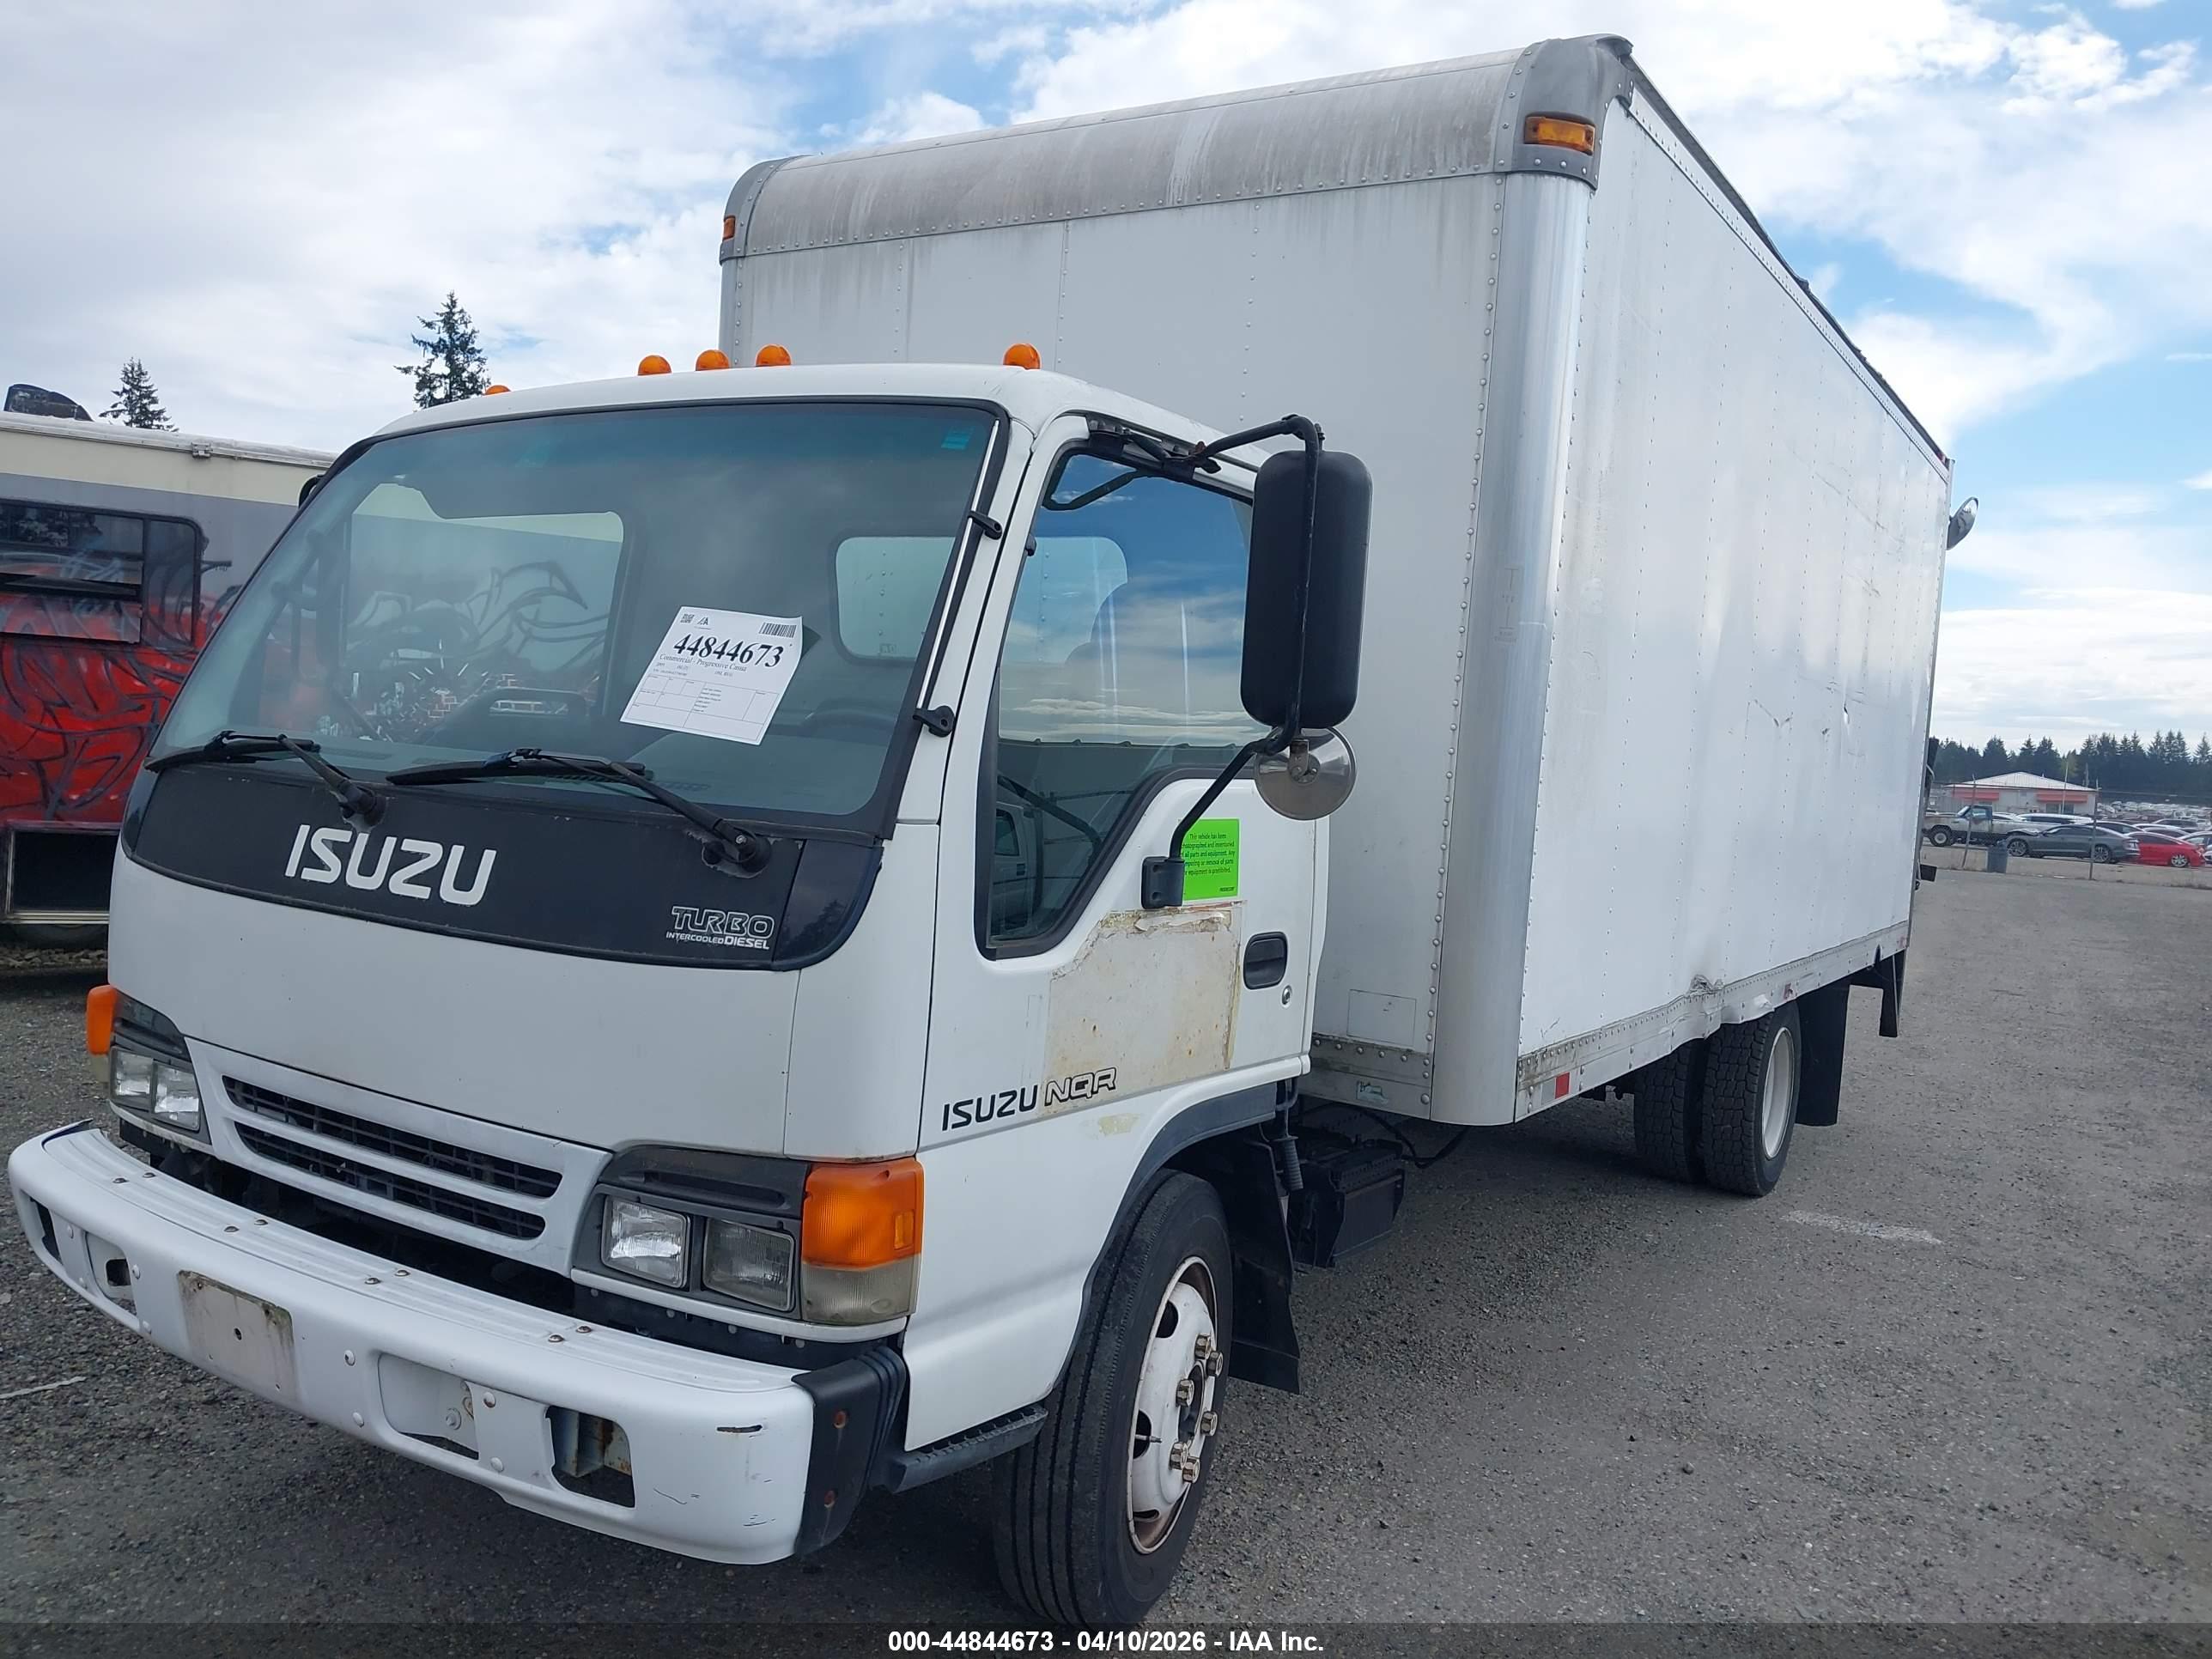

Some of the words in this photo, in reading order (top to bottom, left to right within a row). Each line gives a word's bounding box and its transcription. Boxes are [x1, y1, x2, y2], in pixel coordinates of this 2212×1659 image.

[659, 653, 693, 665] Commercial
[696, 659, 729, 670] Progressive
[673, 633, 785, 668] 44844673
[284, 823, 498, 908] ISUZU
[671, 905, 775, 939] TURBO
[665, 931, 725, 945] INTERCOOLED
[724, 935, 770, 950] DIESEL
[941, 1085, 1039, 1132] ISUZU
[1044, 1066, 1117, 1107] NQR
